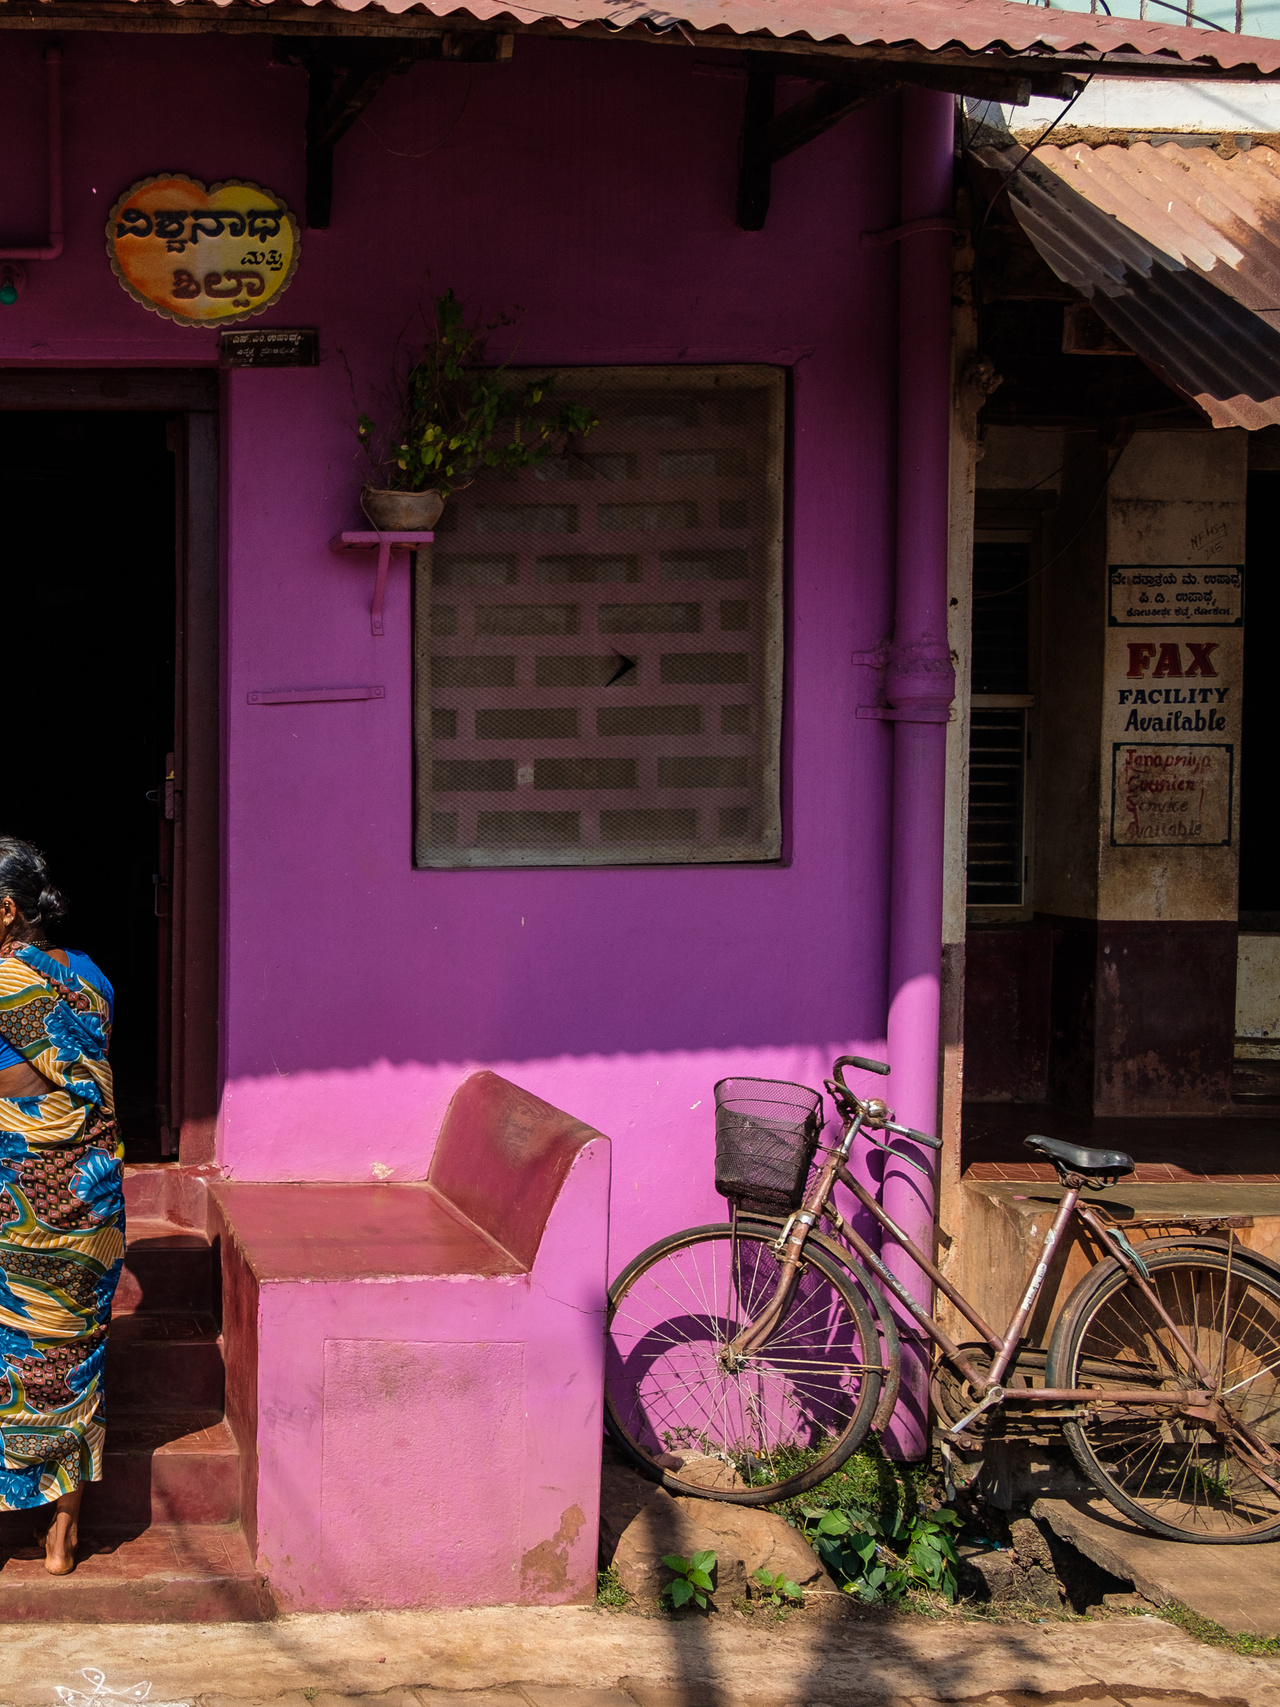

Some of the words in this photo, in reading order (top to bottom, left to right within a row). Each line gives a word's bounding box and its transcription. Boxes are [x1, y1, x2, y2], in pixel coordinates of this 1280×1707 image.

[240, 249, 284, 271] ಮತ್ತು
[1126, 642, 1220, 679] FAX
[1118, 687, 1230, 705] FACILITY
[1124, 709, 1227, 732] Available
